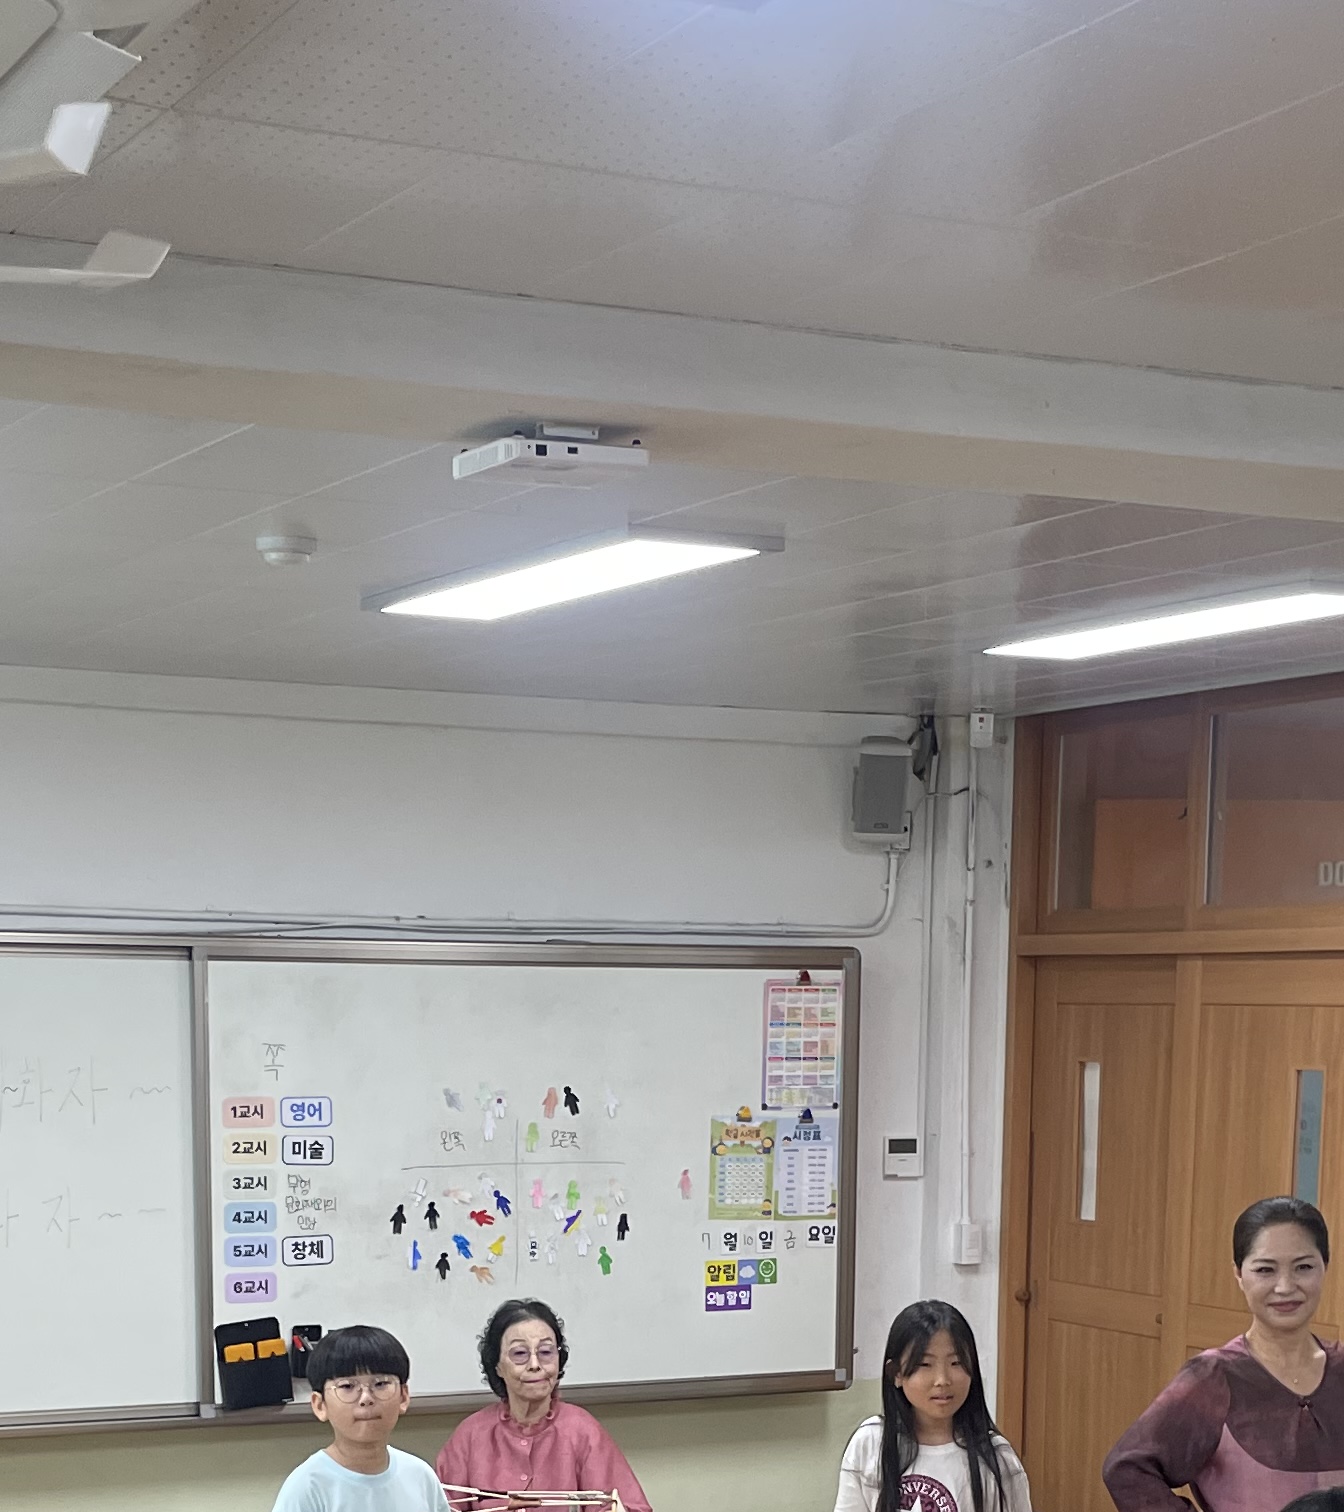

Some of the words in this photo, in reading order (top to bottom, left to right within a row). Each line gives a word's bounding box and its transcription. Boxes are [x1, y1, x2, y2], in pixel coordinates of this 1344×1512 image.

[261, 1043, 286, 1081] 쪽
[230, 1104, 264, 1119] 1교시
[290, 1102, 323, 1121] 영어
[550, 1130, 580, 1150] 오른쪽
[793, 1131, 822, 1141] 시정표
[232, 1140, 267, 1155] 2교시
[292, 1140, 324, 1160] 미술
[232, 1176, 268, 1190] 3교시
[232, 1210, 268, 1224] 4교시
[724, 1232, 738, 1251] 월
[759, 1230, 773, 1249] 일
[784, 1230, 796, 1249] 금
[808, 1225, 836, 1244] 요일
[233, 1243, 268, 1258] 5교시
[291, 1240, 324, 1260] 창체
[707, 1264, 736, 1282] 알림
[233, 1279, 269, 1294] 6교시
